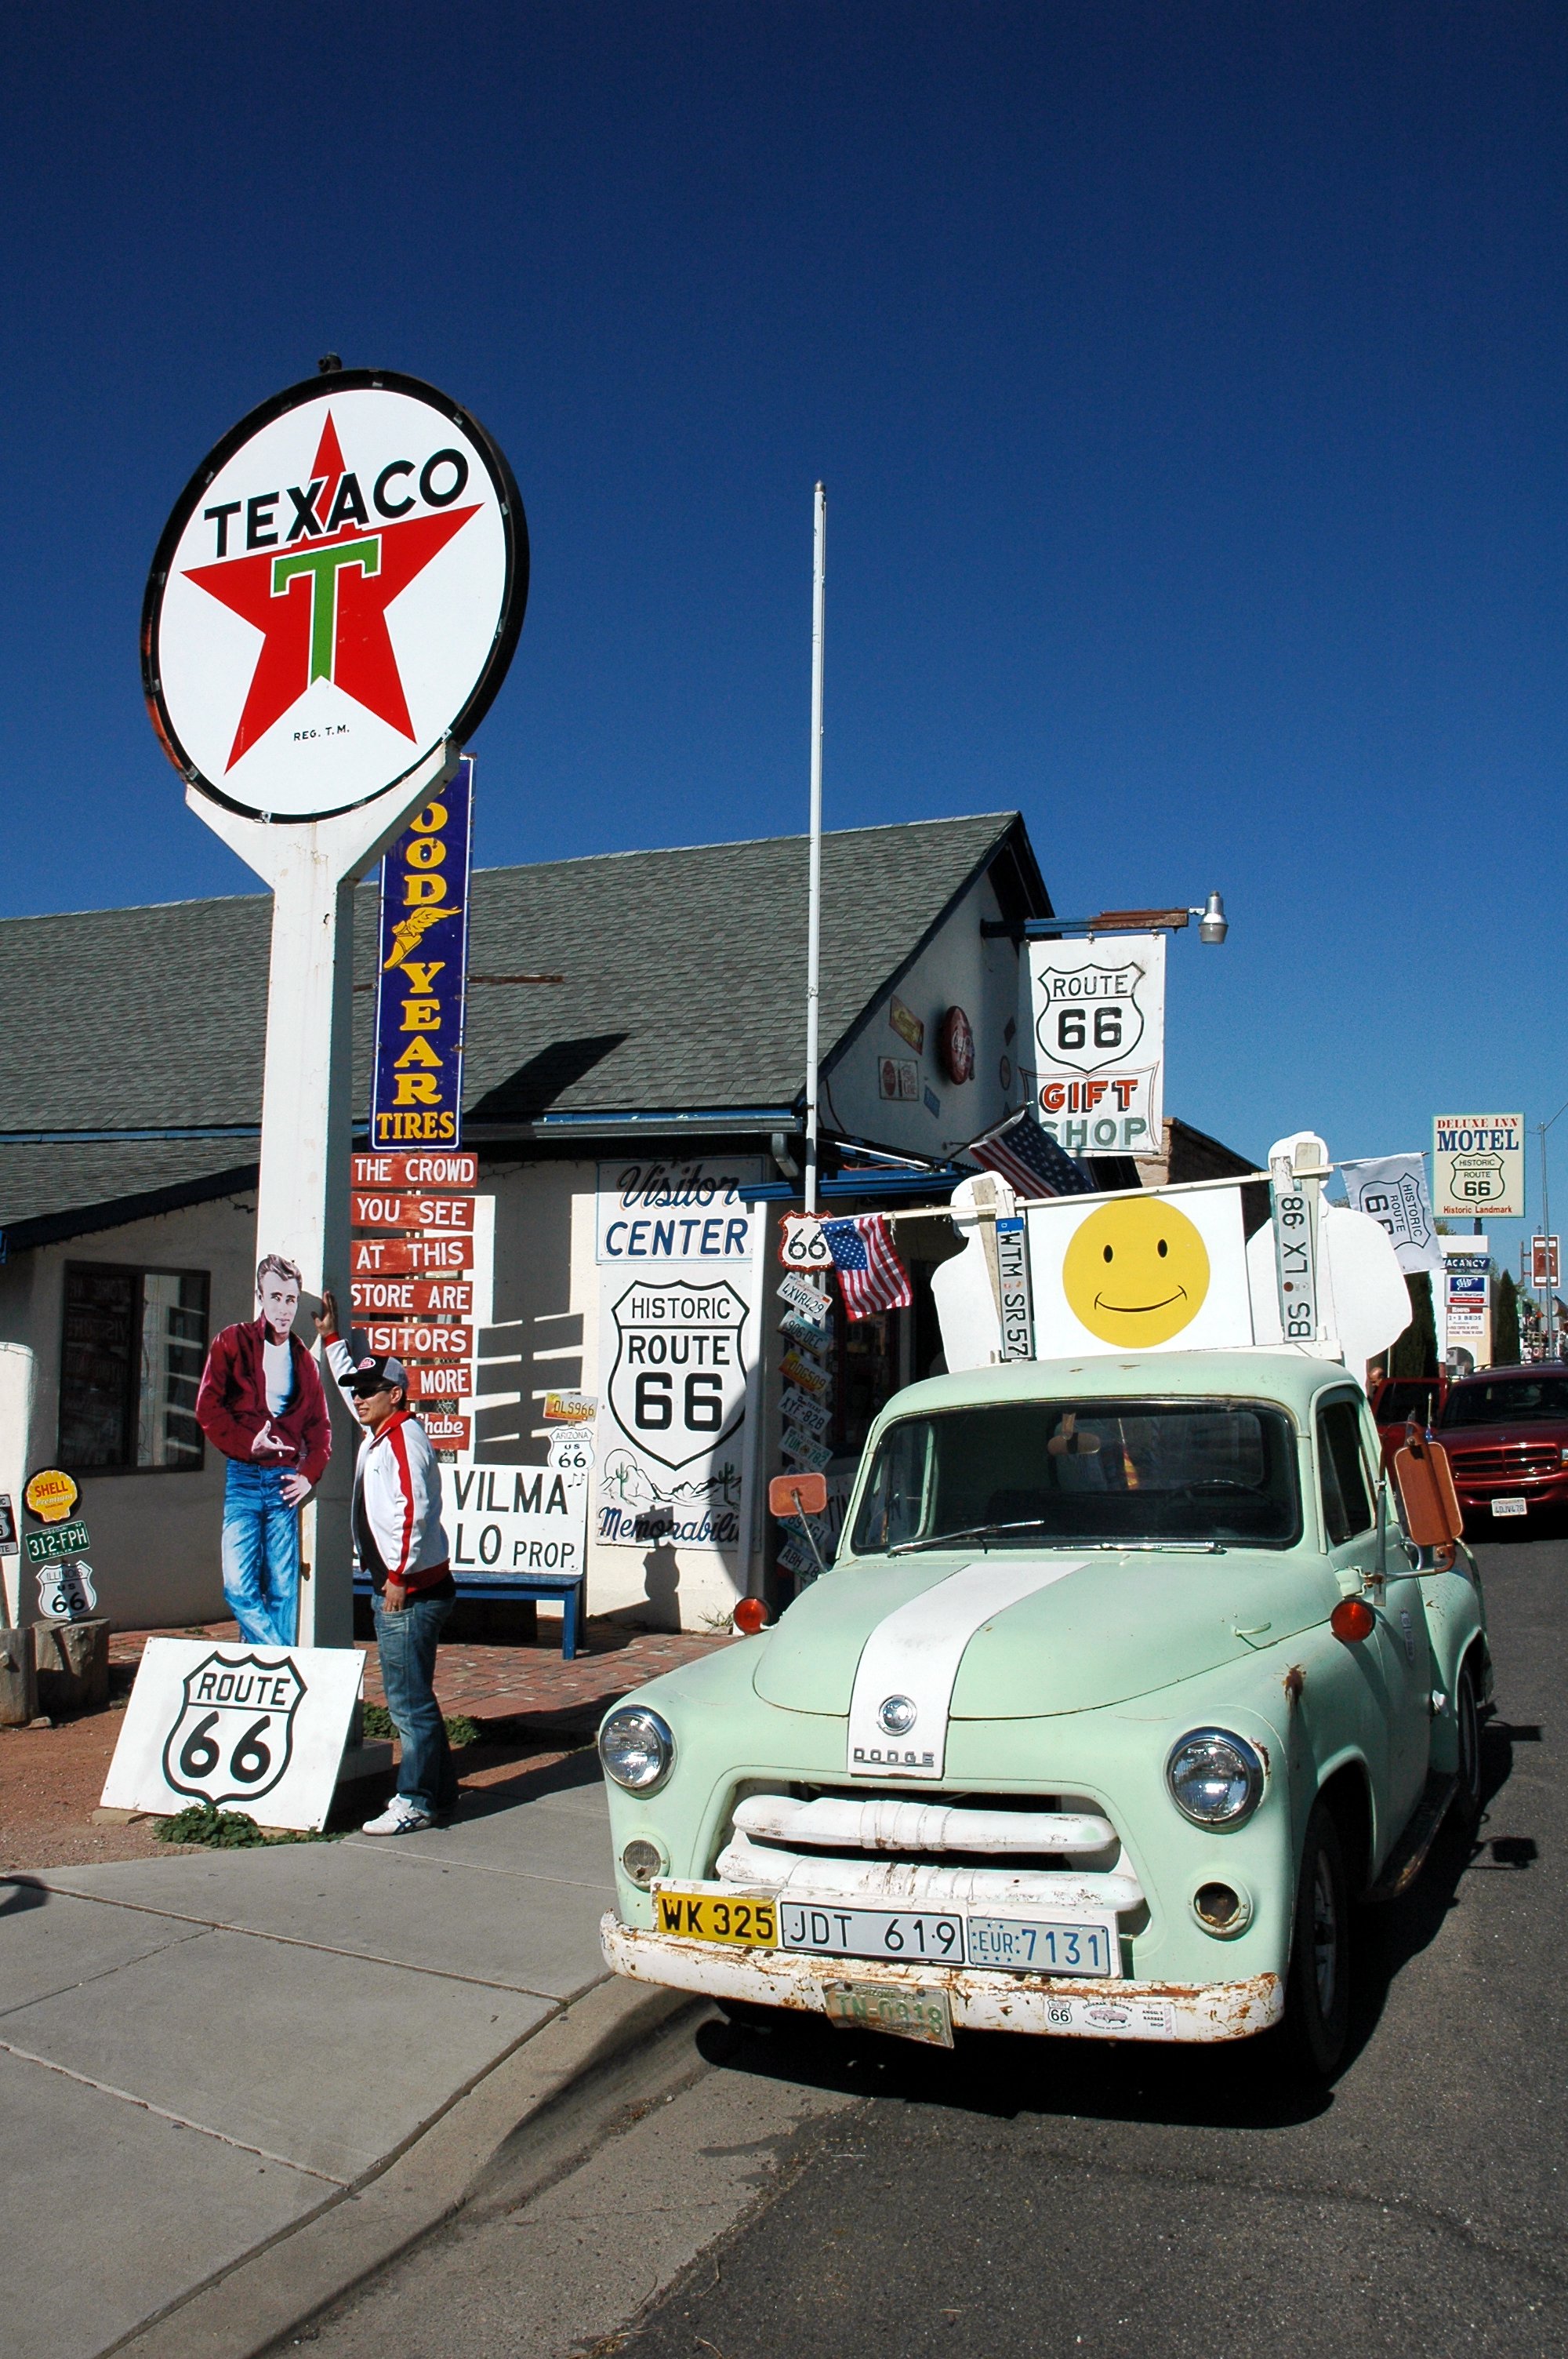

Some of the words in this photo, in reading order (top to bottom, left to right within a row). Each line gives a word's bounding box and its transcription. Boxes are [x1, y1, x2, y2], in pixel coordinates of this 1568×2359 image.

[205, 449, 469, 558] TEXACO
[271, 534, 382, 685] T
[293, 729, 321, 741] REG.
[1053, 974, 1127, 998] ROUTE
[1058, 1006, 1122, 1049] 66
[1040, 1079, 1138, 1114] GIFT
[376, 1112, 454, 1140] TIRES
[1039, 1117, 1147, 1148] SHOP
[1438, 1118, 1488, 1129] DELUXE
[1494, 1118, 1519, 1127] INN
[1437, 1129, 1519, 1151] MOTEL
[355, 1159, 392, 1182] THE
[405, 1158, 474, 1182] CROWD
[617, 1163, 739, 1209] Visitor
[1465, 1181, 1490, 1196] 66
[358, 1198, 400, 1223] YOU
[419, 1201, 467, 1226] SEE
[1281, 1197, 1305, 1226] 98
[1390, 1195, 1406, 1232] ROUTE
[1403, 1184, 1422, 1237] HISTORIC
[606, 1218, 749, 1256] CENTER
[788, 1228, 826, 1260] 66
[357, 1245, 385, 1270] AT
[407, 1241, 464, 1267] THIS
[1000, 1232, 1022, 1277] WTM
[1283, 1242, 1308, 1274] LX
[351, 1284, 414, 1308] STORE
[428, 1285, 470, 1310] ARE
[630, 1297, 731, 1319] HISTORIC
[782, 1283, 824, 1314] 4XVR429
[1288, 1302, 1311, 1337] BS
[368, 1327, 467, 1353] ISITORS
[628, 1335, 730, 1365] ROUTE
[420, 1369, 469, 1394] MORE
[634, 1372, 723, 1432] 66
[556, 1431, 588, 1440] ARIZONA
[559, 1452, 586, 1468] 66
[34, 1481, 69, 1498] SHELL
[35, 1494, 73, 1507] Premium
[454, 1470, 568, 1514] VILMA
[599, 1506, 739, 1541] Memorabili
[29, 1528, 88, 1557] 312-FPH
[782, 1550, 804, 1568] ABH
[46, 1568, 82, 1581] ILLINOIS
[52, 1592, 85, 1613] 66
[197, 1673, 291, 1706] ROUTE
[180, 1711, 271, 1783] 66
[854, 1747, 935, 1768] DODGE
[662, 1898, 704, 1933] WK
[713, 1903, 773, 1939] 325
[789, 1910, 852, 1947] JDT
[979, 1930, 1014, 1954] EUR
[1022, 1928, 1099, 1967] 7131
[1051, 2009, 1069, 2022] 66
